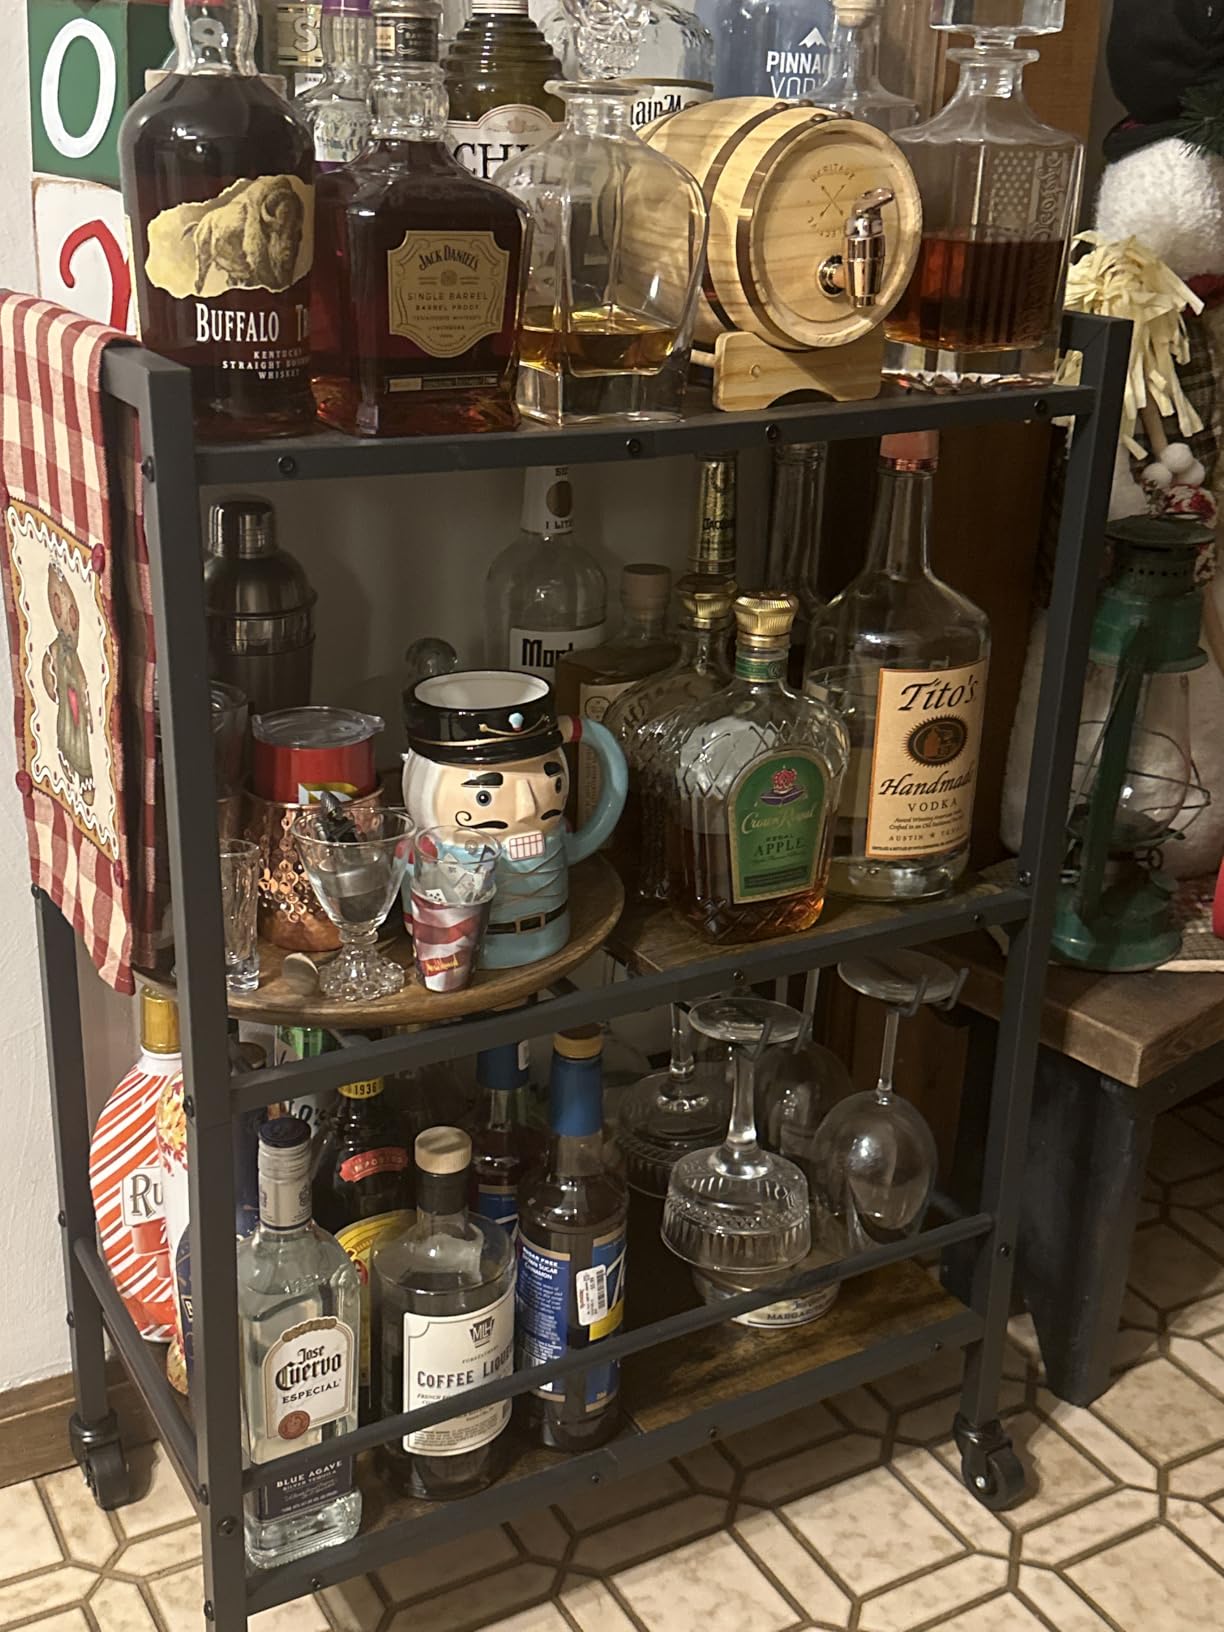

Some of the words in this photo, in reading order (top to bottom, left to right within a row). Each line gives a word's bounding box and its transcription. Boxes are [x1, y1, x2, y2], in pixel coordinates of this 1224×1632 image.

[770, 75, 822, 98] VOD
[418, 248, 445, 271] JACK
[407, 292, 445, 301] SINGLE
[448, 291, 489, 301] BARREL
[415, 303, 449, 311] BARREL
[451, 303, 480, 311] PROOF
[195, 302, 280, 343] BUFFALO
[222, 360, 281, 370] STRAIGHT
[897, 674, 979, 711] Tito's
[908, 797, 958, 812] VODKA
[753, 837, 802, 857] APPLE
[354, 1082, 377, 1096] 1936
[275, 1352, 342, 1391] Cuervo
[416, 1369, 475, 1389] COFFEE
[281, 1380, 341, 1405] ESPECIAL
[275, 1473, 306, 1489] BLUE
[307, 1459, 343, 1478] AGAVE
